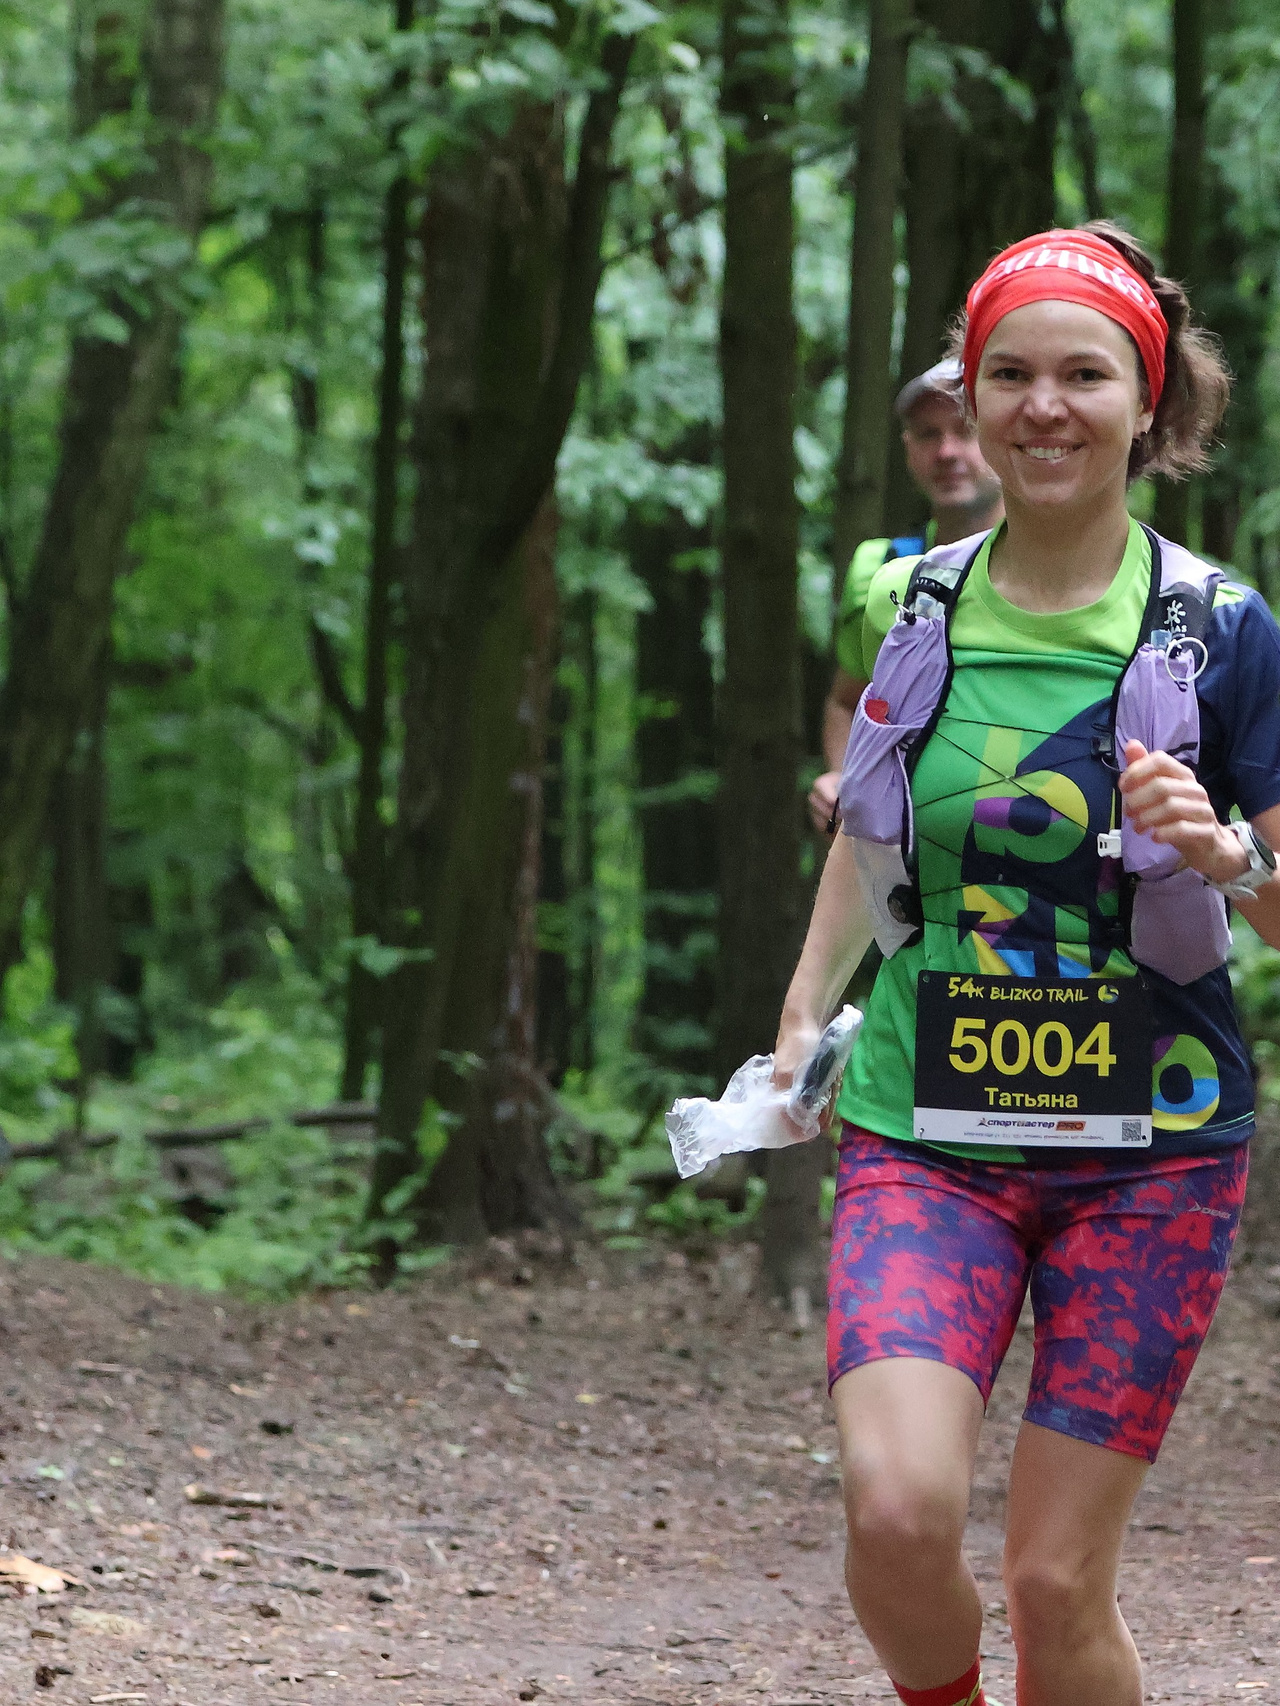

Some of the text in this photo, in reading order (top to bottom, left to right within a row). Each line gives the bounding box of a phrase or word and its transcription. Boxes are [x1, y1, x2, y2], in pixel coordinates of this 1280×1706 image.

[990, 985, 1043, 1002] BLIZKO
[1047, 987, 1089, 1003] TRAIL
[948, 1016, 1117, 1077] 5004
[984, 1086, 1078, 1109] Татьяна
[1056, 1120, 1085, 1130] PRO
